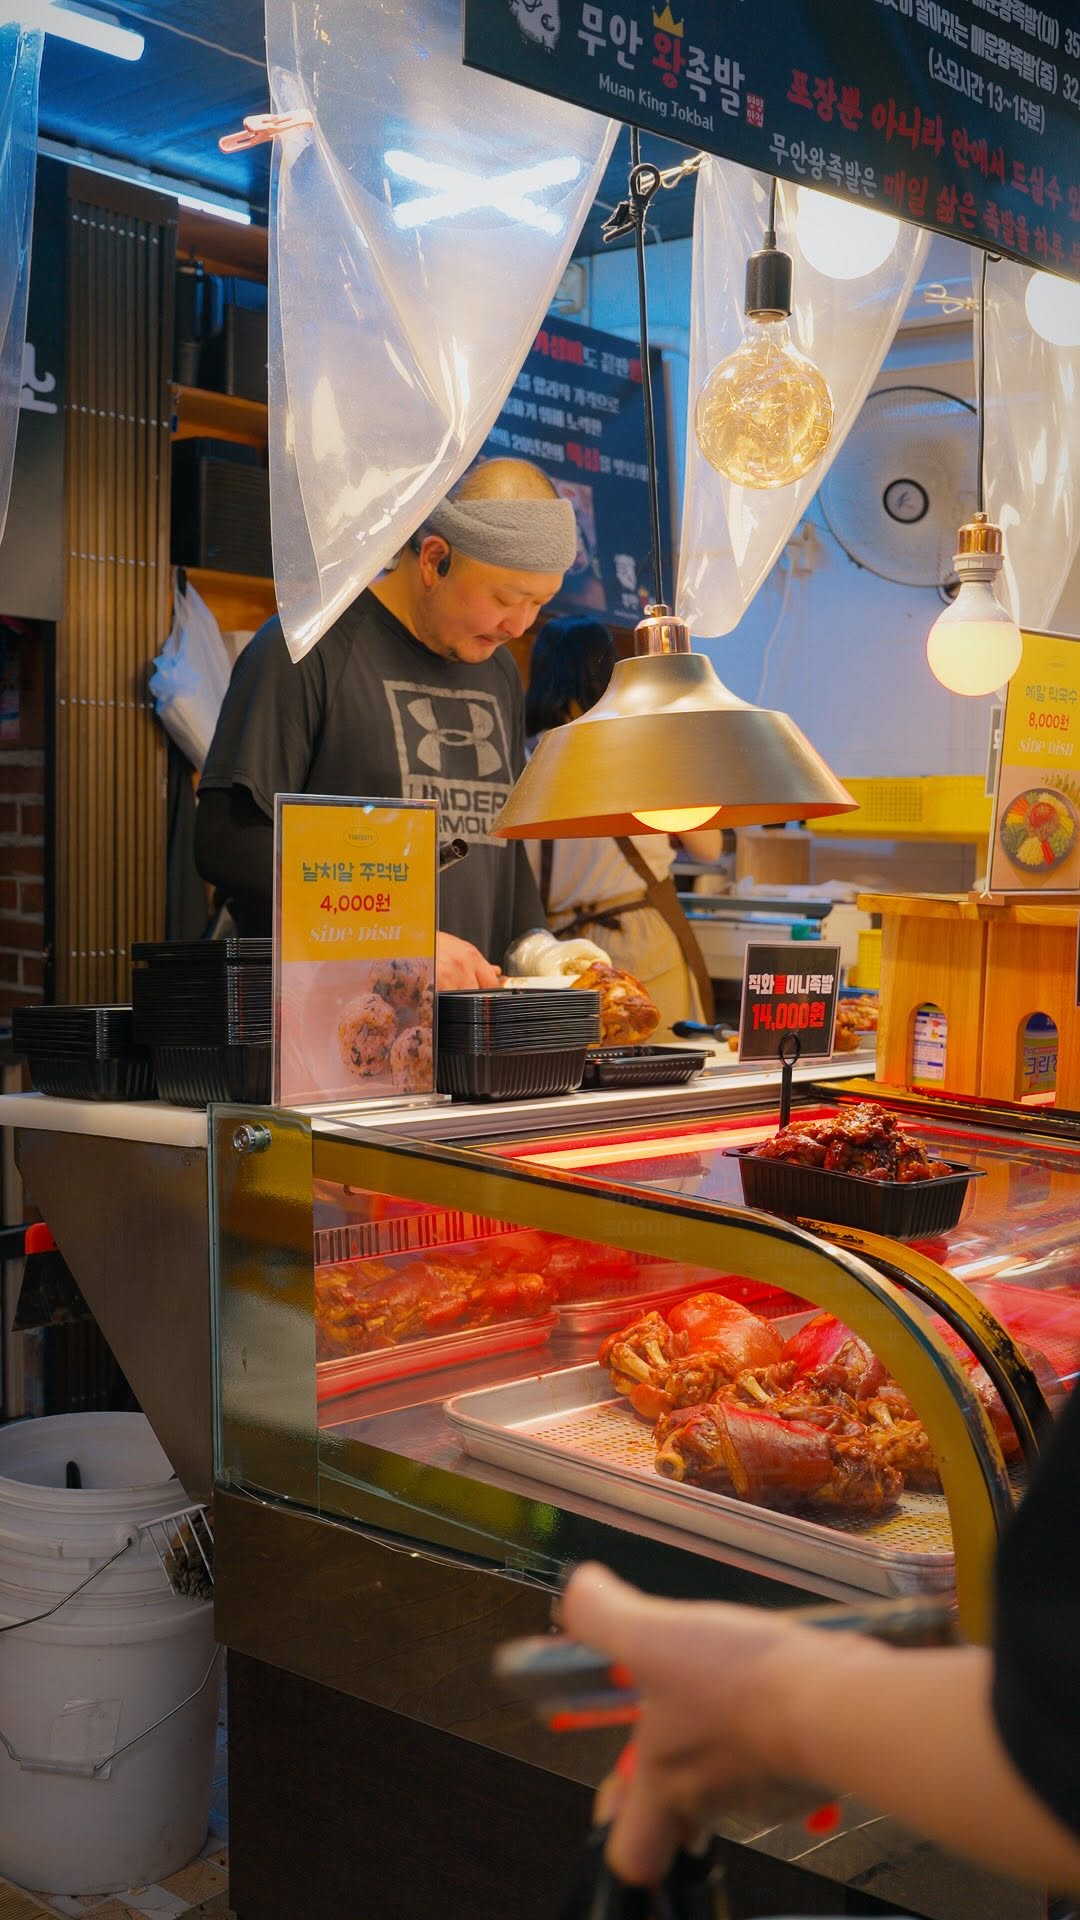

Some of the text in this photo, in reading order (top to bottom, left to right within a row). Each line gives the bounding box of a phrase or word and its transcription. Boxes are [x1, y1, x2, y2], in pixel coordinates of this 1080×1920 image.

[971, 24, 1058, 95] 매운왕족발(중)
[599, 73, 714, 132] Muan King Jokbal
[929, 47, 1046, 135] (소요시간 13~15분)
[786, 68, 864, 131] 포장뿐
[871, 98, 946, 158] 아니라
[952, 127, 1006, 185] 안에서
[1011, 160, 1063, 212] 드실수
[769, 132, 877, 199] 무안왕족발은
[883, 170, 929, 217] 매일
[936, 183, 977, 229] 삶은
[983, 199, 1029, 254] 족발을
[1028, 711, 1070, 731] 8,000원
[302, 862, 410, 883] 날치알 주먹밥
[320, 893, 391, 915] 4,000원
[751, 1001, 826, 1031] 14,000원
